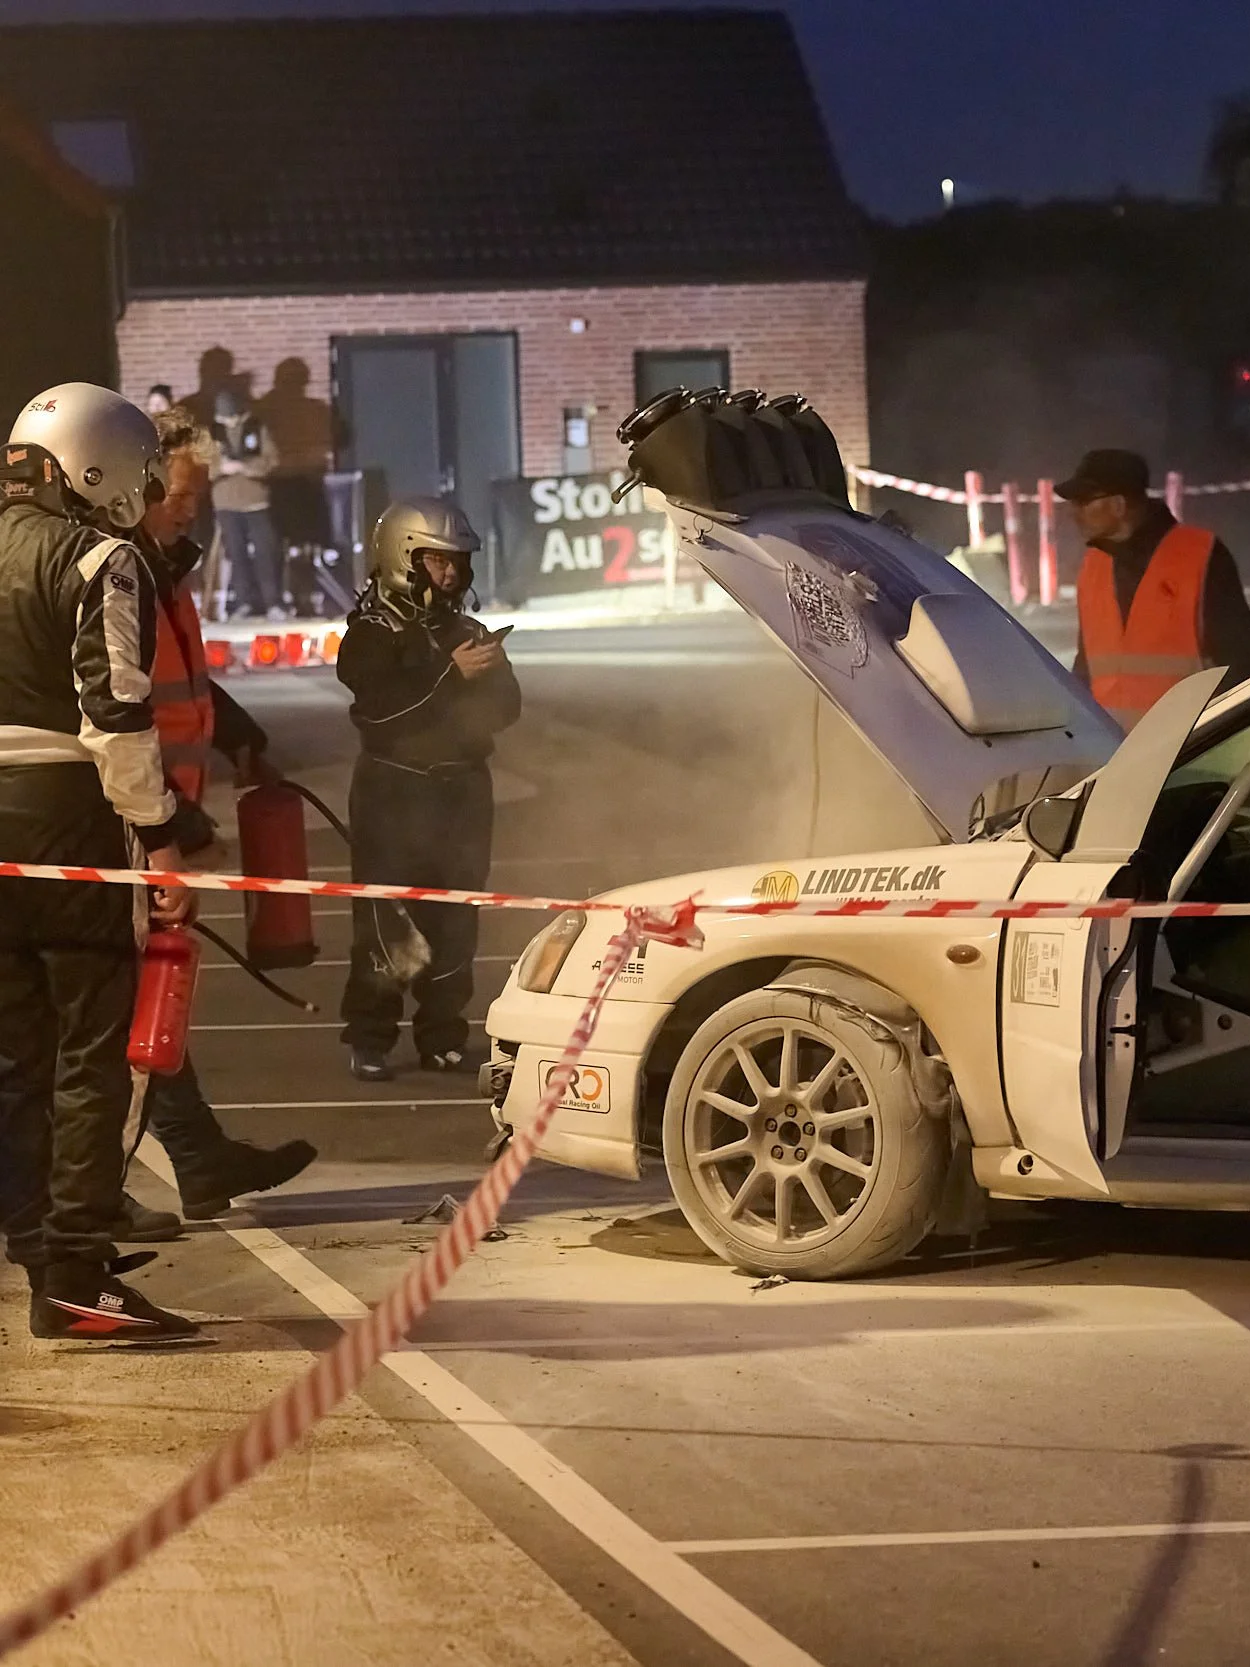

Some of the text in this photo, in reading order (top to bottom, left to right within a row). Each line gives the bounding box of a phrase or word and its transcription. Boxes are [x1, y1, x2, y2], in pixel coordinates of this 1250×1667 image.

[540, 525, 668, 583] Au2s
[800, 865, 946, 896] LINDTEK.dk
[569, 1099, 591, 1109] Racing
[99, 1295, 124, 1306] OMP
